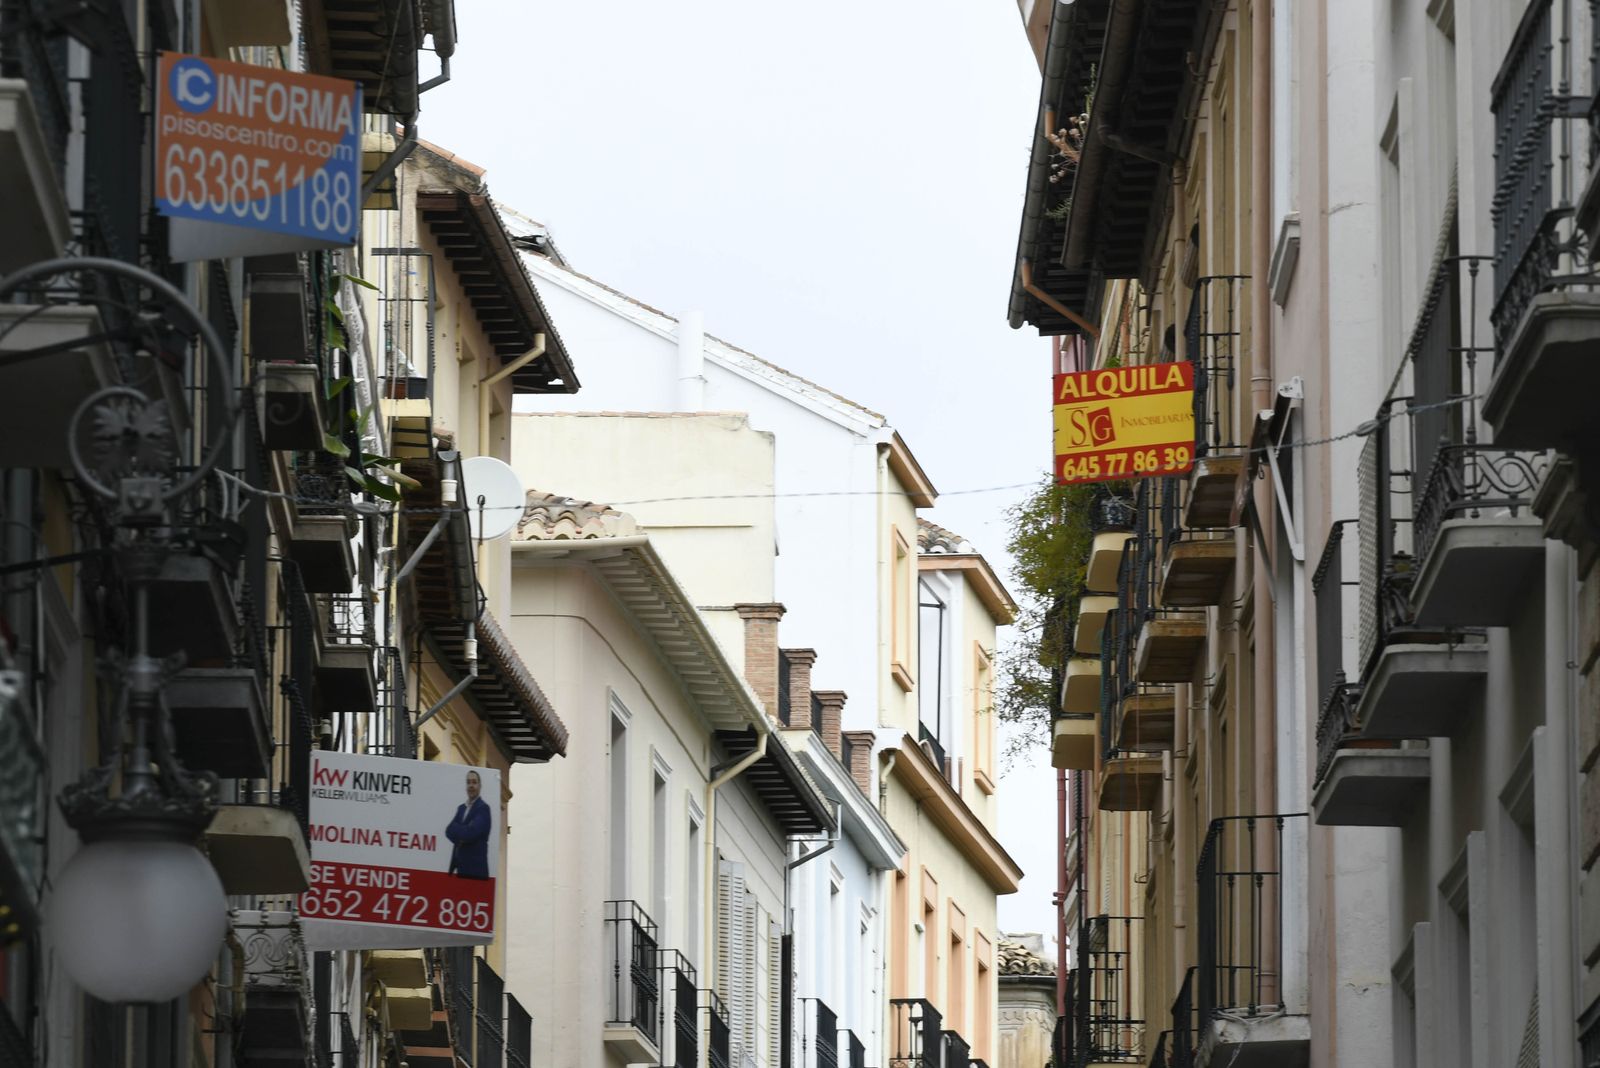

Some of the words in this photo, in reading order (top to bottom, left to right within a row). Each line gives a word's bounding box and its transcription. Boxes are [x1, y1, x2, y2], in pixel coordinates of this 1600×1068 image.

[217, 73, 355, 135] INFORMA
[162, 112, 353, 162] pisoscentro.com
[165, 143, 352, 235] 633851188
[1060, 364, 1185, 399] ALQUILA
[1070, 408, 1114, 447] SG
[1063, 456, 1101, 482] 645
[1105, 452, 1128, 477] 77
[1133, 449, 1158, 472] 86
[1163, 446, 1190, 471] 39
[352, 770, 411, 795] KINVER
[308, 824, 383, 847] MOLINA
[387, 831, 437, 852] TEAM
[309, 864, 335, 884] SE
[341, 867, 410, 890] VENDE
[301, 887, 362, 918] 652
[372, 892, 429, 924] 472
[438, 898, 489, 930] 895
